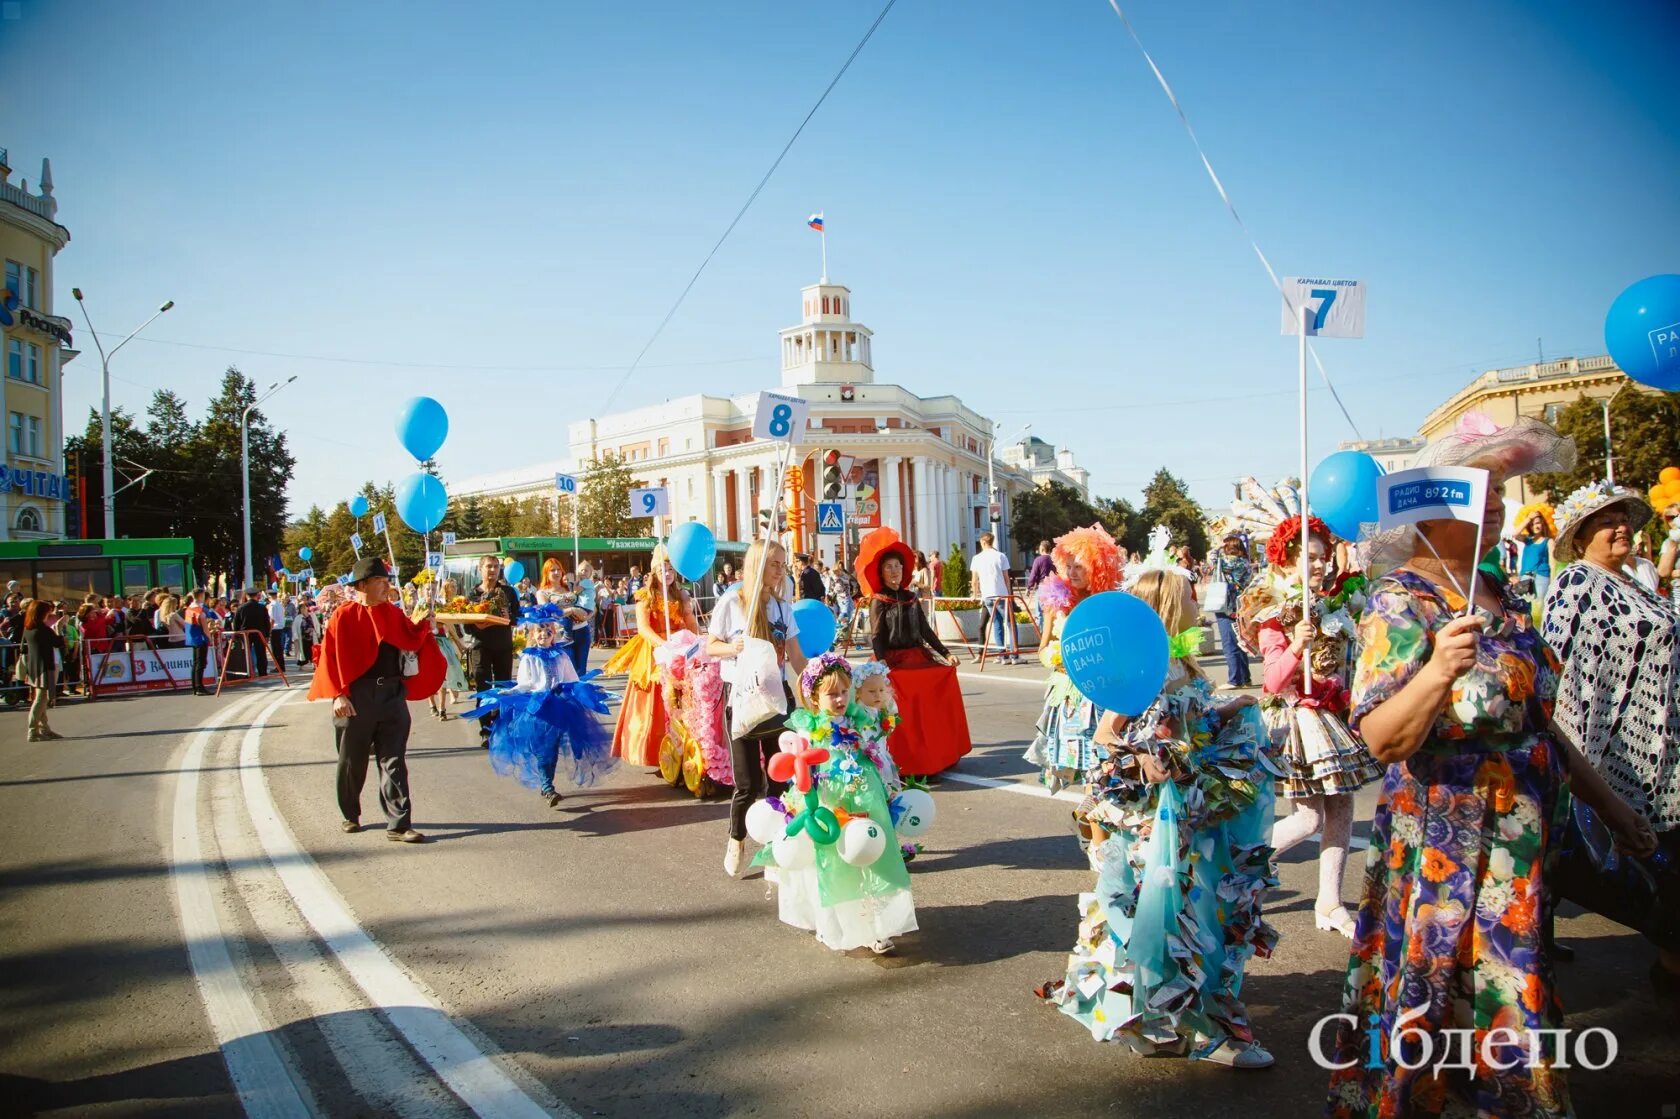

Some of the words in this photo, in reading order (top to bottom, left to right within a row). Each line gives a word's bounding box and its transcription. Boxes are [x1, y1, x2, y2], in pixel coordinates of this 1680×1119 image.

[1311, 289, 1337, 330] 7
[769, 404, 792, 437] 8
[559, 477, 574, 492] 10
[1394, 486, 1420, 497] РАДИО
[1451, 489, 1464, 499] fm
[642, 493, 656, 513] 9
[1398, 497, 1418, 508] ДАЧА
[376, 515, 385, 531] 11
[429, 555, 440, 566] 12
[1064, 633, 1104, 656] РАДИО
[1073, 653, 1104, 672] ДАЧА
